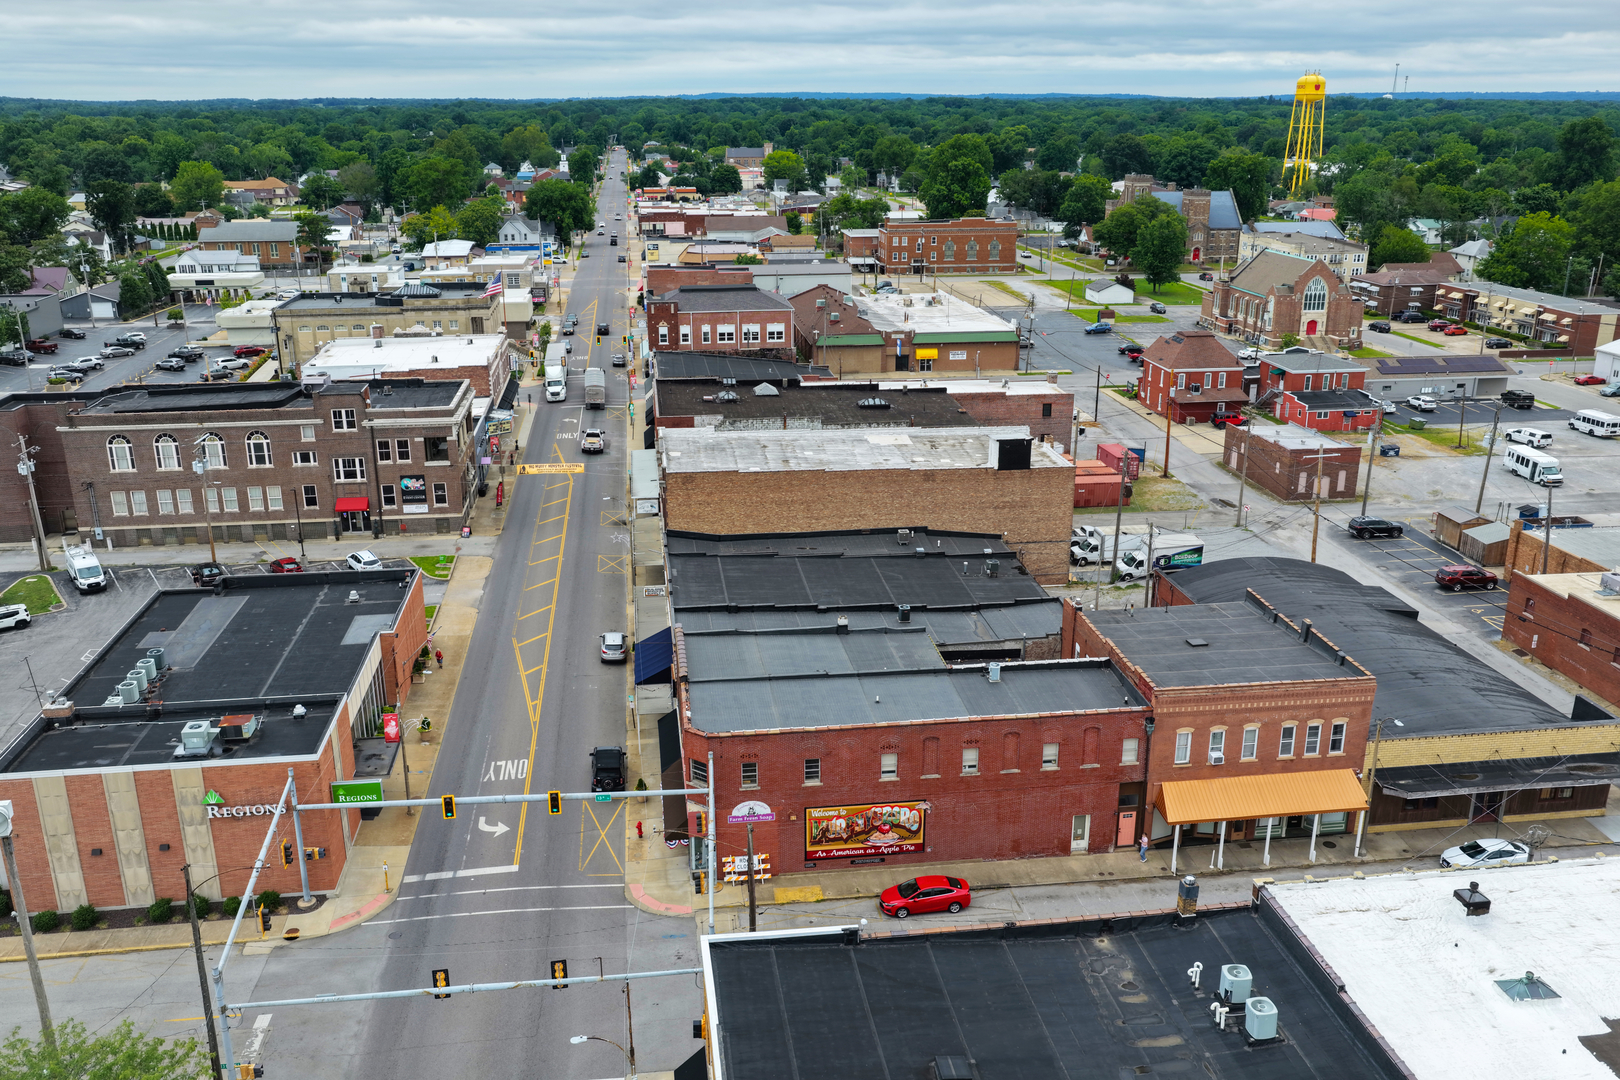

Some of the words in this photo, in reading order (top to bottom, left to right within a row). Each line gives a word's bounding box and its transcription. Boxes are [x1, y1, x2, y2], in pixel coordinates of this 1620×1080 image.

[483, 758, 528, 782] ONLY
[339, 794, 377, 803] REGIONS
[206, 804, 286, 819] REGIONS
[811, 809, 839, 817] Welcome
[810, 806, 920, 840] MURPHYSBORO
[876, 846, 899, 854] Apple
